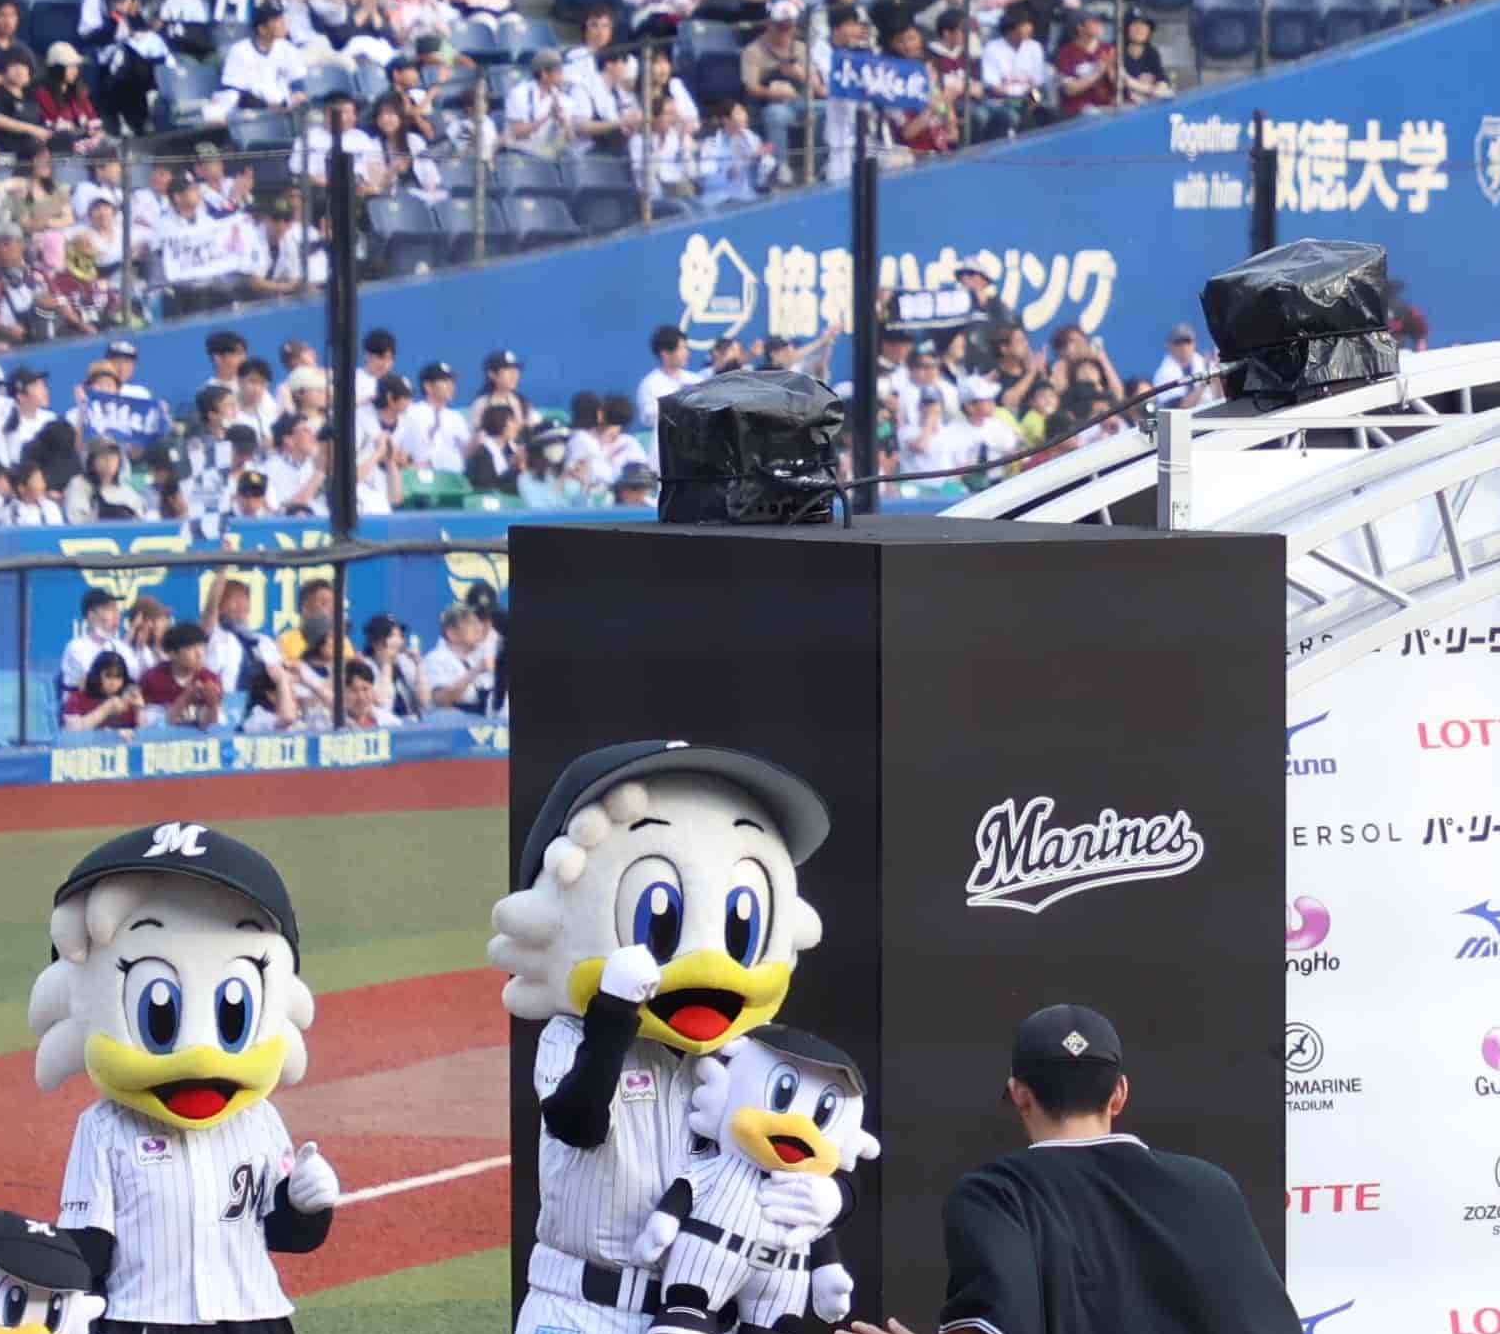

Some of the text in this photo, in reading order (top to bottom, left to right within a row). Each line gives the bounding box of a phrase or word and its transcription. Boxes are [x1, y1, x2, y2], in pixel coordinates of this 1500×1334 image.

[1287, 757, 1337, 775] ZUNO
[141, 821, 211, 858] M
[1294, 822, 1402, 846] ERSOL
[967, 795, 1204, 899] Marines
[1287, 952, 1339, 977] ngHo
[1287, 1077, 1362, 1095] OMARINE
[1287, 1099, 1334, 1111] TADIUM
[1287, 1183, 1380, 1212] TTE
